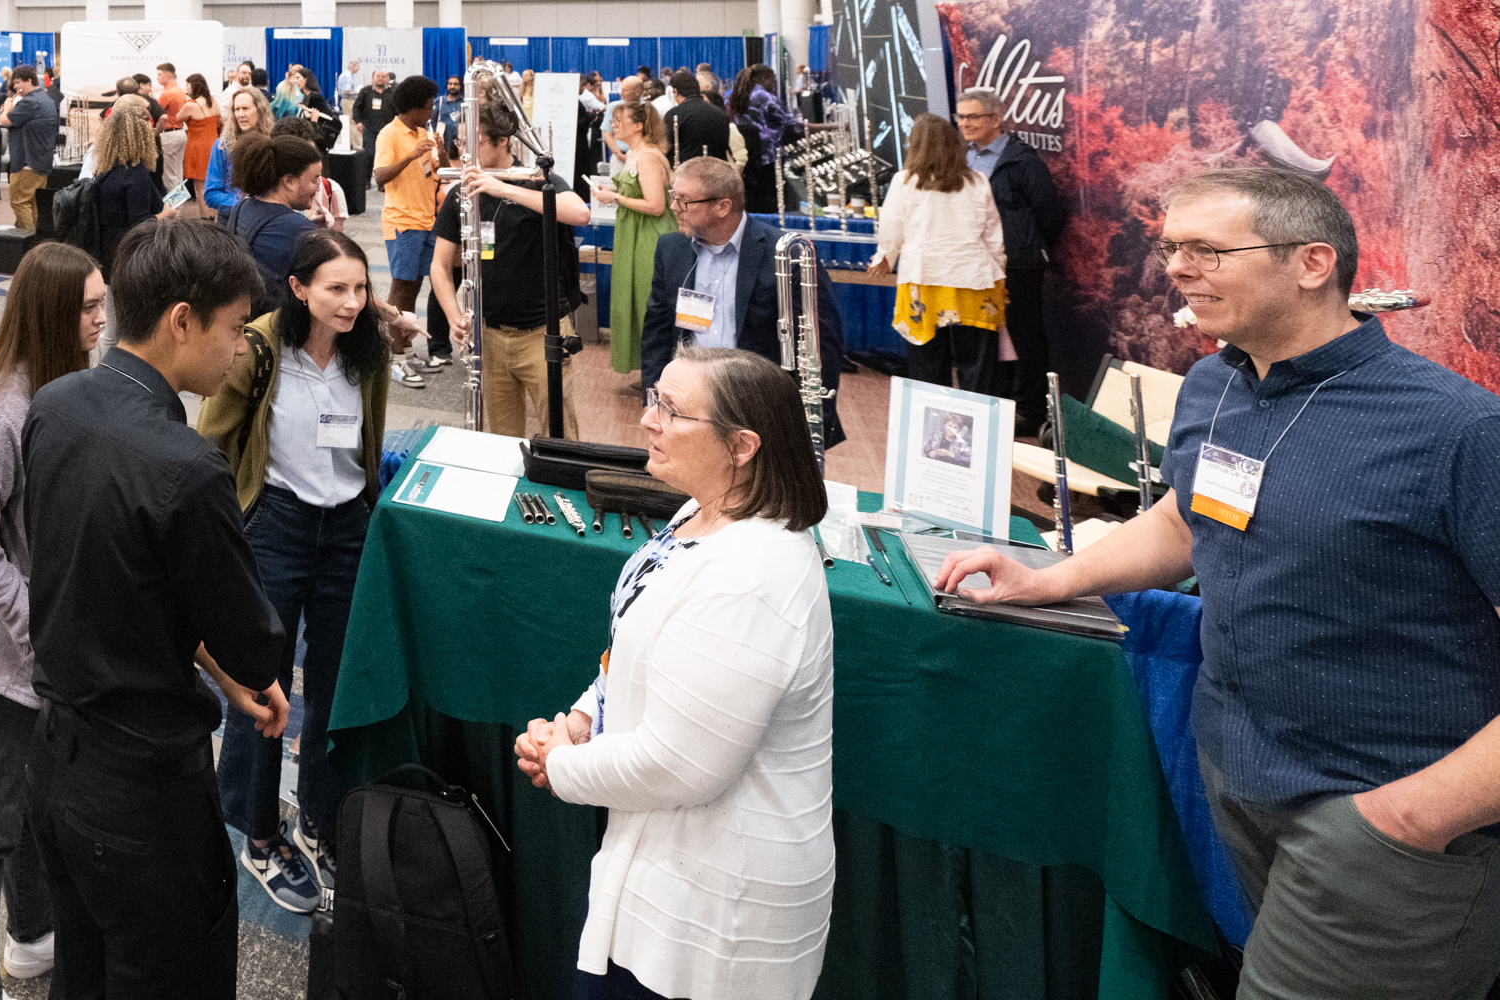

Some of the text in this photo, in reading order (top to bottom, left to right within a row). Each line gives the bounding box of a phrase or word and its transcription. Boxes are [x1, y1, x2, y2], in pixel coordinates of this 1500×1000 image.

[357, 56, 406, 65] NAGAHARA
[958, 34, 1066, 128] Altus
[1229, 469, 1251, 480] Carer
